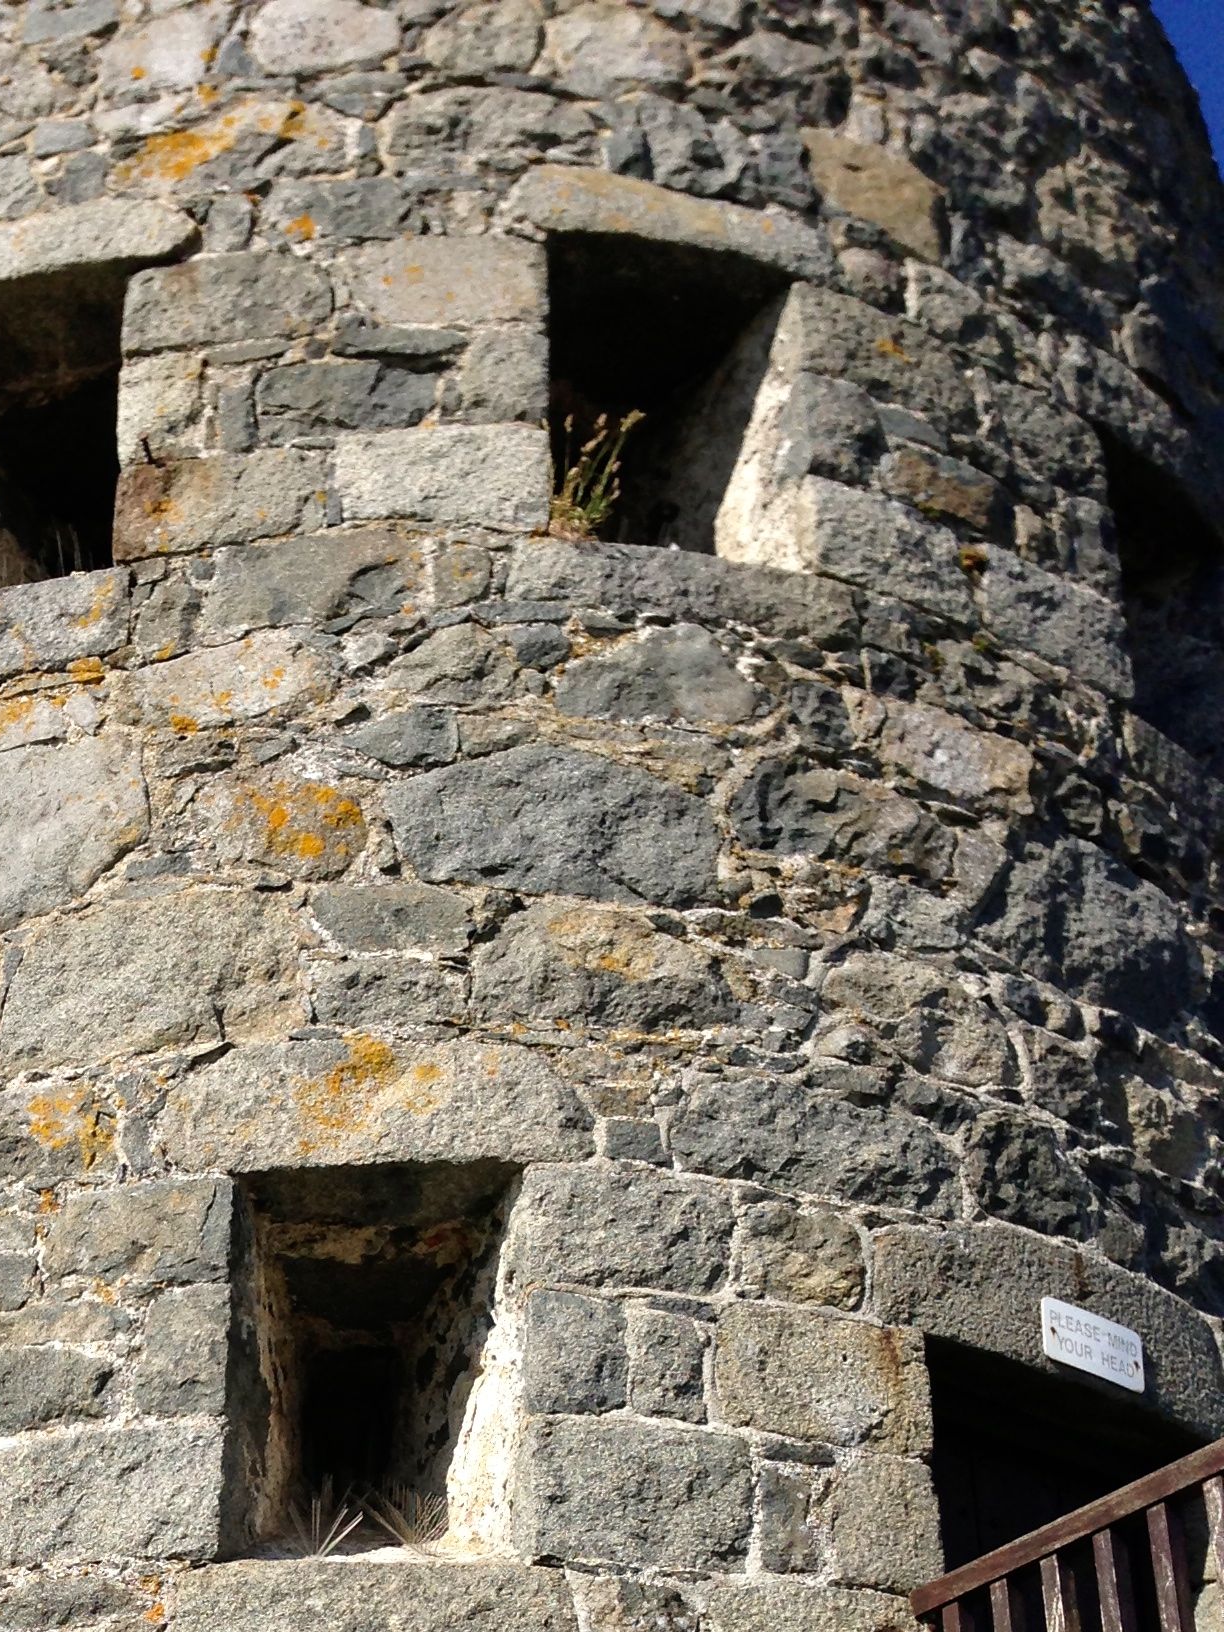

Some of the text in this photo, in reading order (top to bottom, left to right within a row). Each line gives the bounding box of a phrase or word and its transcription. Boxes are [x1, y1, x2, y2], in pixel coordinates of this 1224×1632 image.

[1049, 1309, 1101, 1342] PLEASE
[1056, 1332, 1135, 1378] YOUR HEAD
